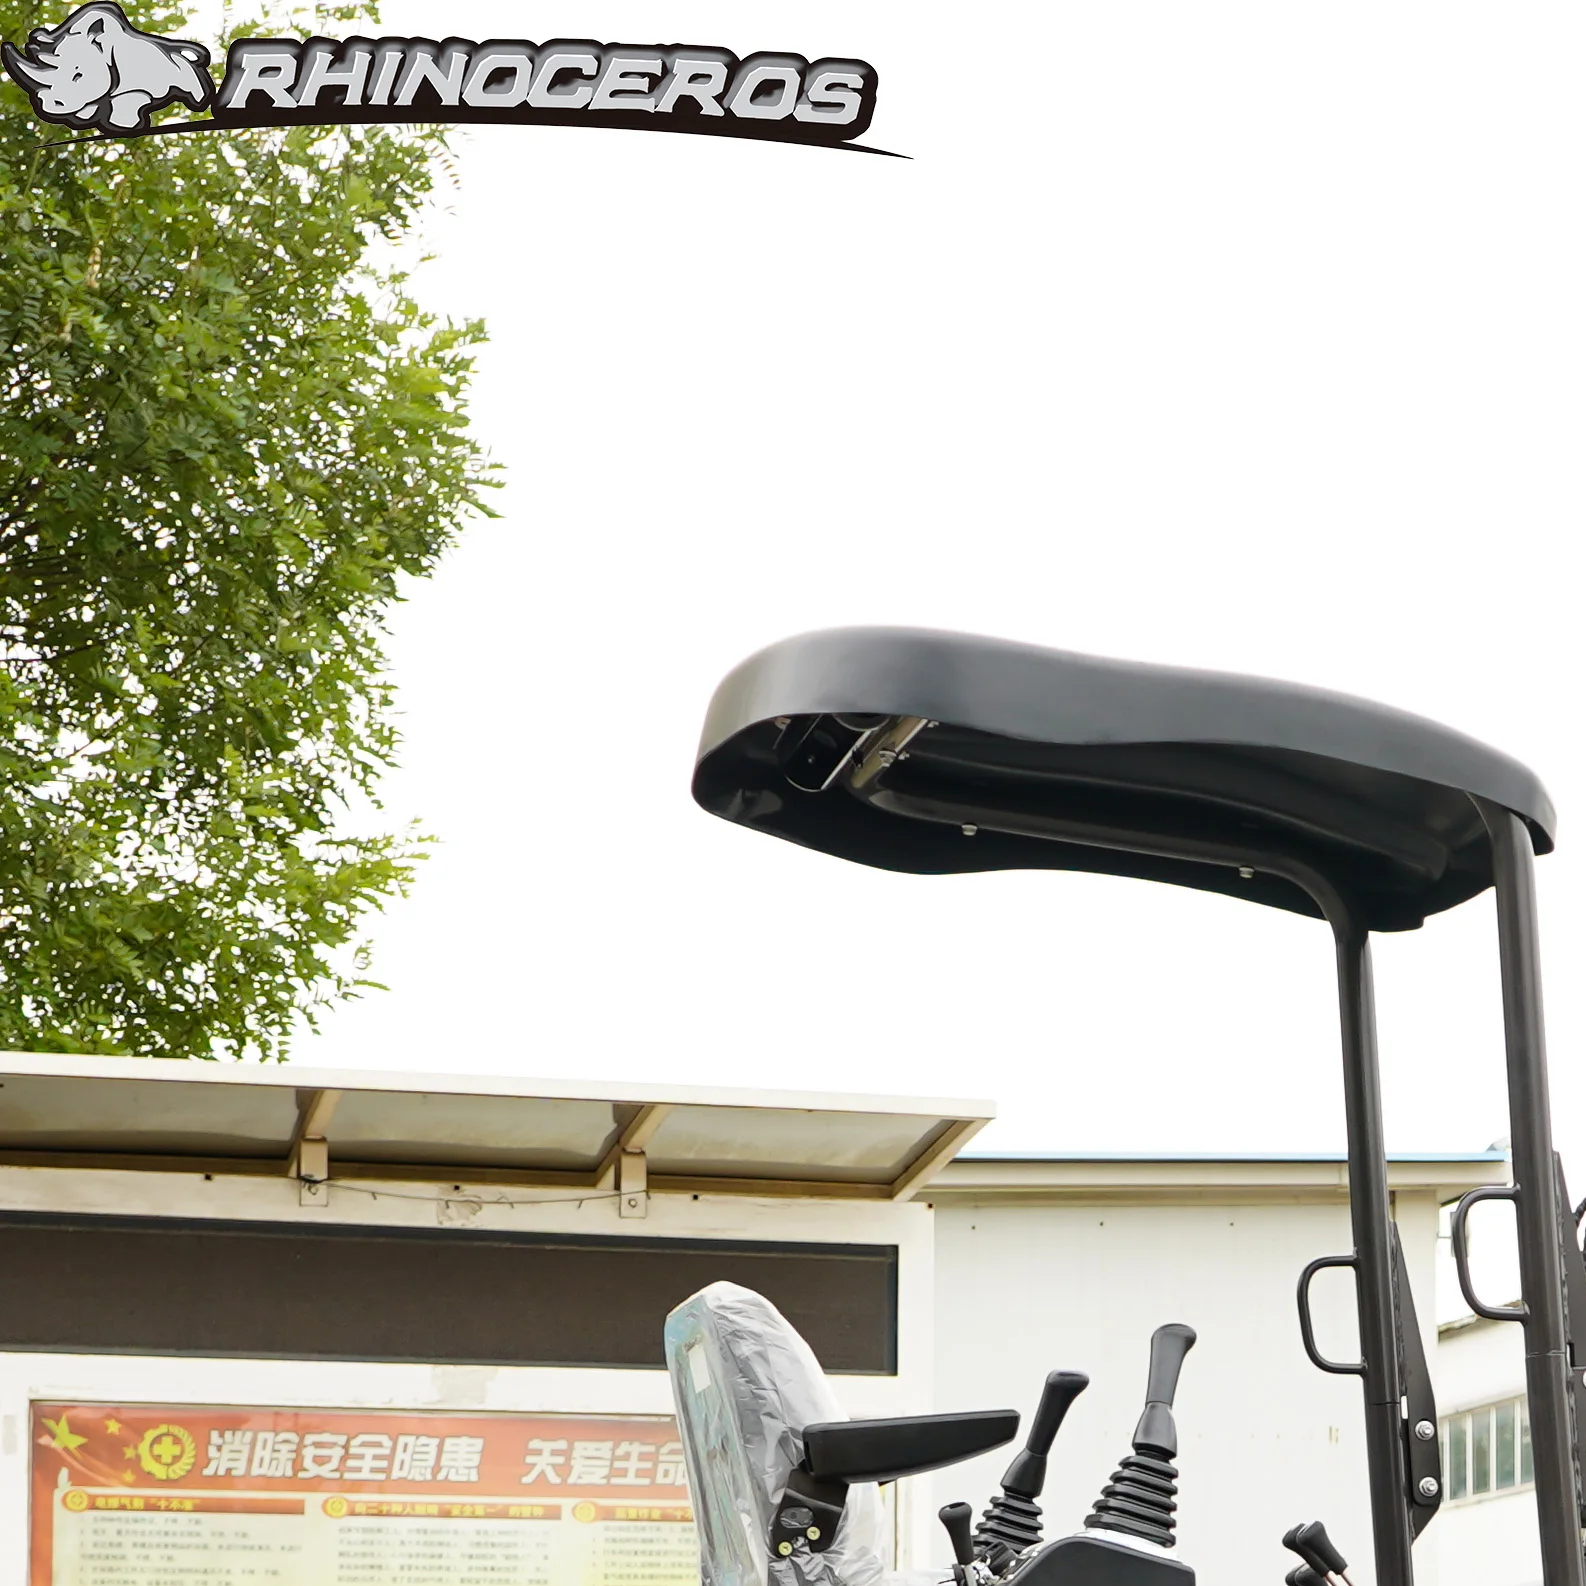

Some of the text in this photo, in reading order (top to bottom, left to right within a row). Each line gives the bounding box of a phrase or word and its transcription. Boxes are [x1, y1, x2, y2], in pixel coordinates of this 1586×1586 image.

[202, 1428, 686, 1487] 消除安全隐患 关爱生命
